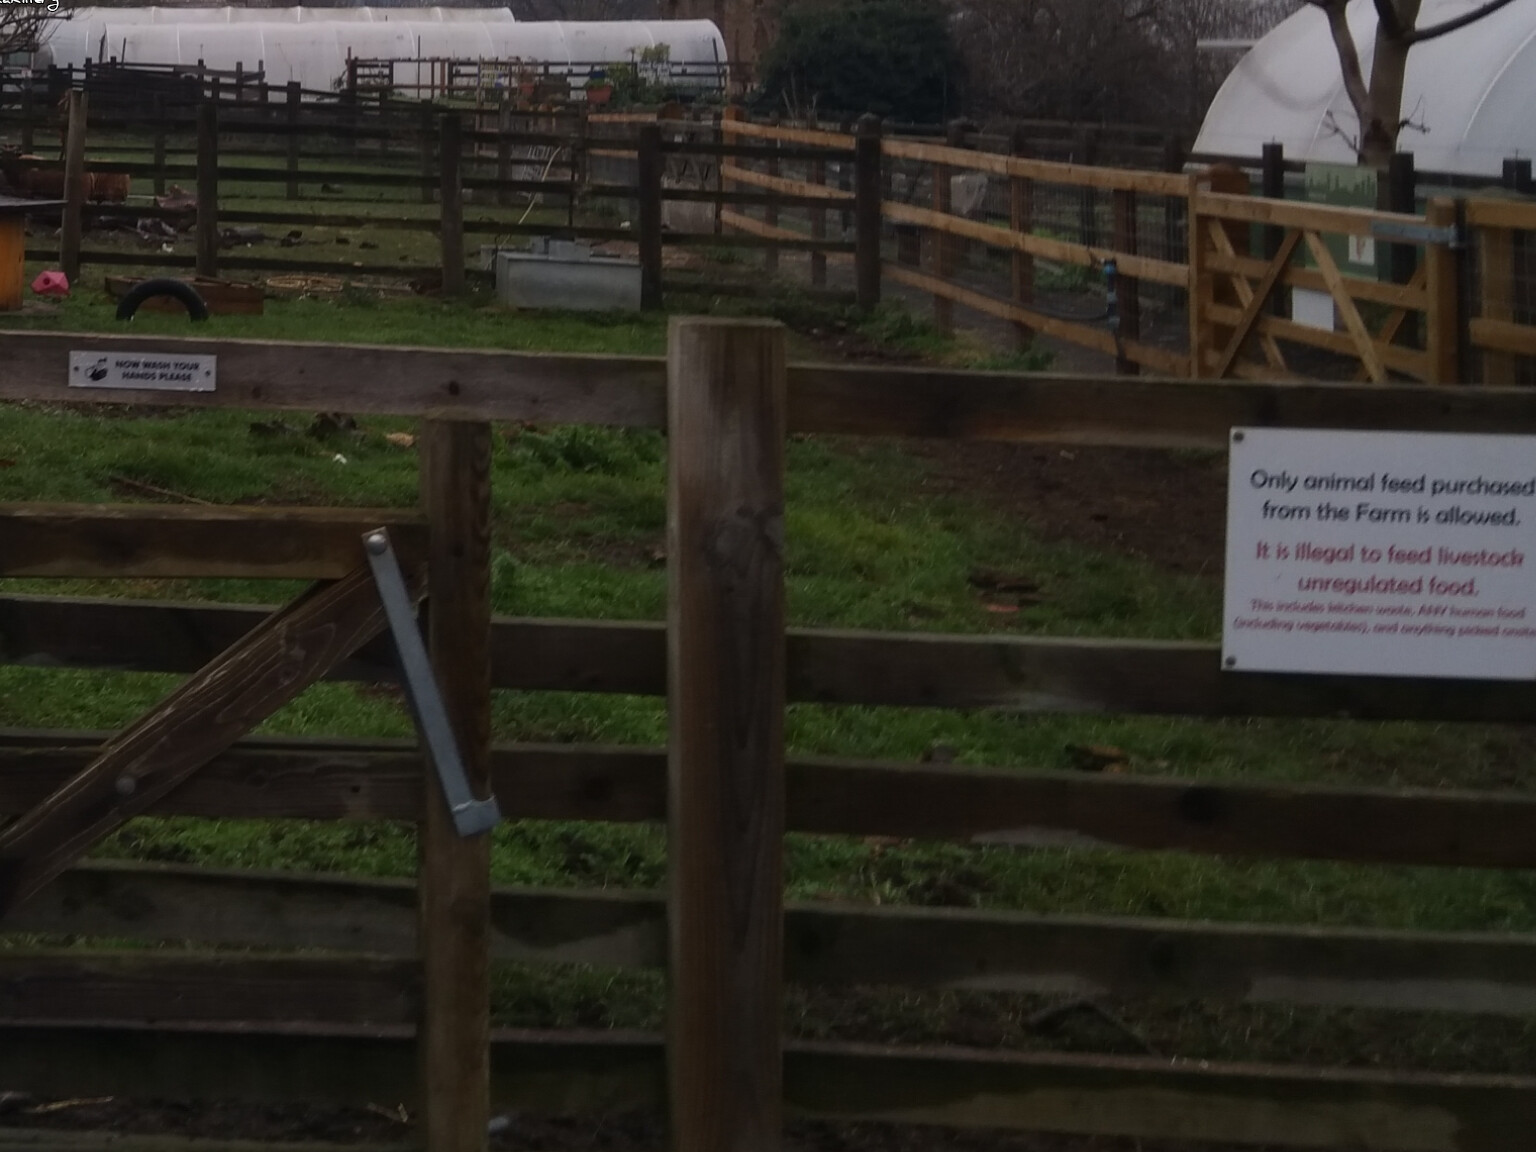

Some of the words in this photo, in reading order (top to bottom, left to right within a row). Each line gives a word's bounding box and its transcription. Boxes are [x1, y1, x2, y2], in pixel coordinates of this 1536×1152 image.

[122, 371, 156, 381] HANDS
[159, 372, 192, 382] PLEASE
[142, 360, 170, 370] WASH
[173, 361, 200, 371] YOUR
[1249, 468, 1298, 492] Only
[1303, 472, 1375, 493] animal
[1381, 473, 1425, 495] feed
[1430, 476, 1536, 498] purchased
[1262, 500, 1311, 521] from
[1316, 502, 1349, 522] the
[1355, 503, 1411, 524] Farm
[1416, 506, 1430, 524] is
[1435, 505, 1521, 527] allowed.
[1256, 540, 1270, 560] It
[1276, 542, 1289, 561] is
[1295, 542, 1355, 565] illegal
[1361, 545, 1382, 564] to
[1387, 544, 1432, 566] feed
[1437, 546, 1525, 568] livestock
[1298, 575, 1423, 597] unregulated
[1428, 576, 1480, 597] food.
